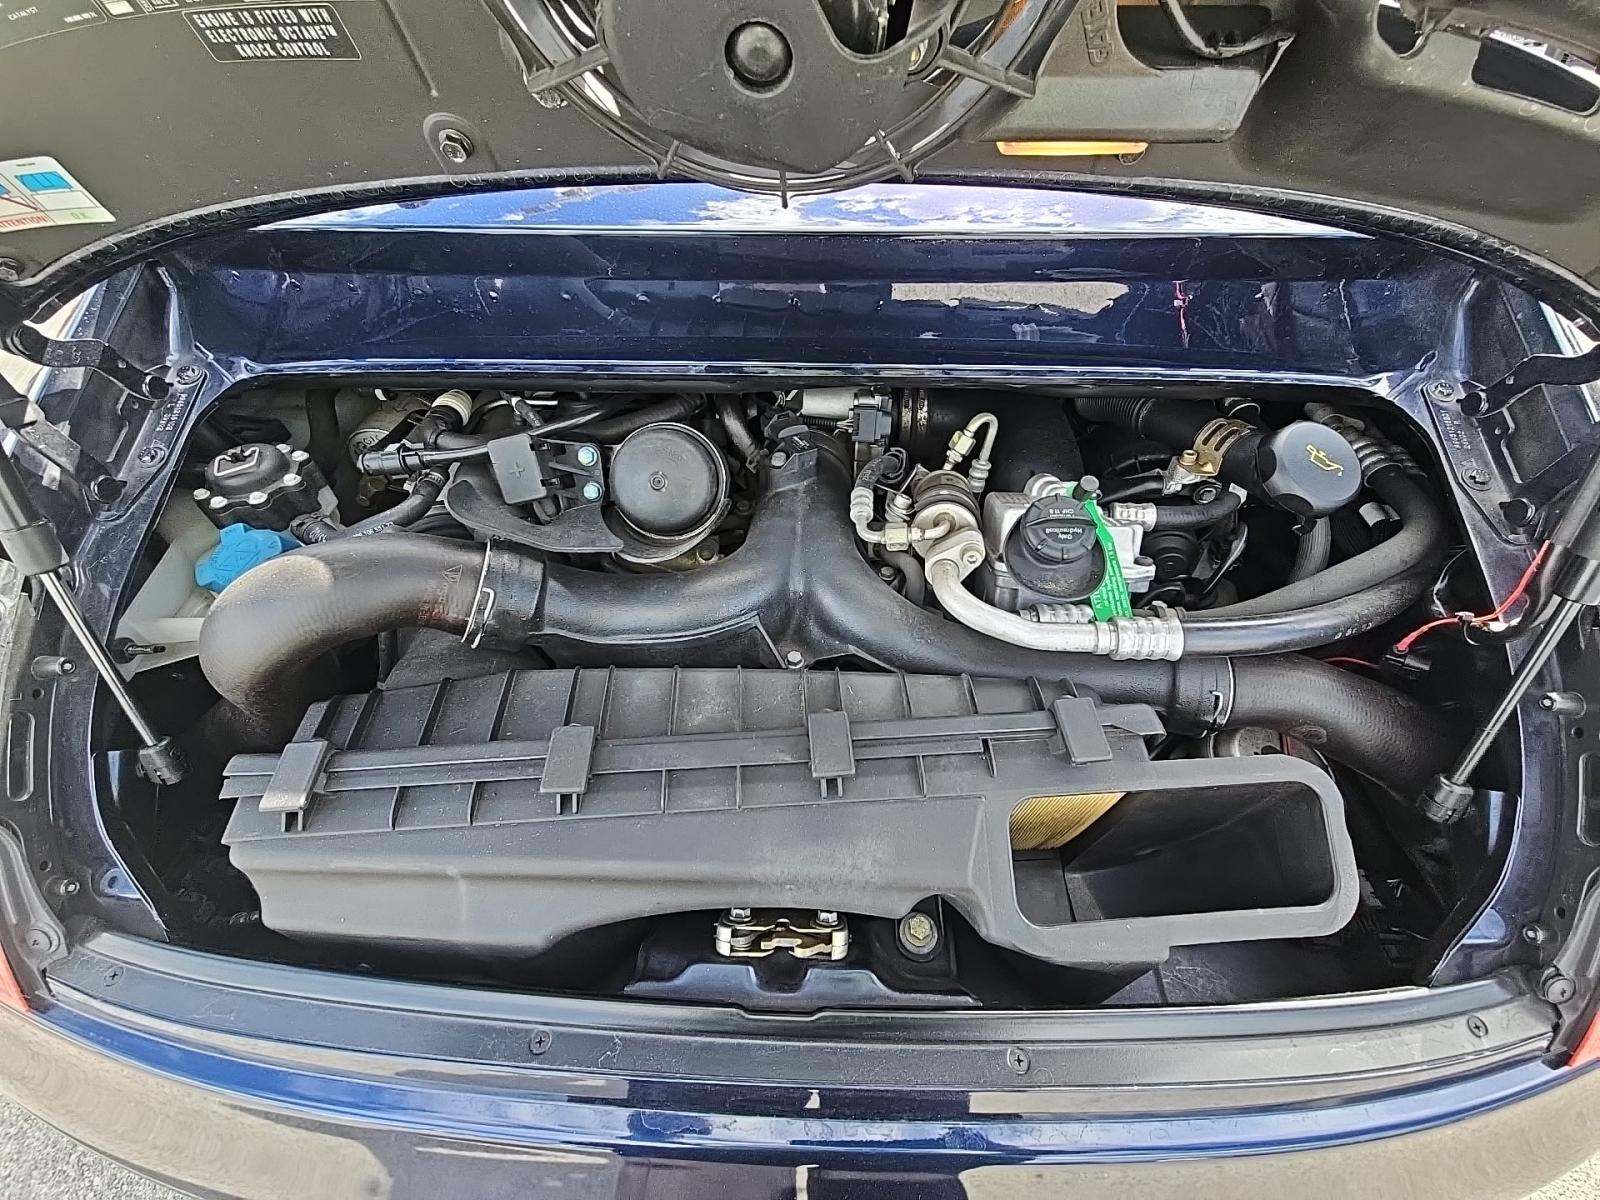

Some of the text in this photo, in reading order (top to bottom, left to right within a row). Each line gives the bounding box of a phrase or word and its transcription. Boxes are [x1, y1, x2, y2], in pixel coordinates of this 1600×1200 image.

[192, 8, 333, 28] ENGINE IS FITTED WITH
[204, 26, 278, 43] ELECTRONIC
[234, 42, 332, 58] KNOCK CONTROL
